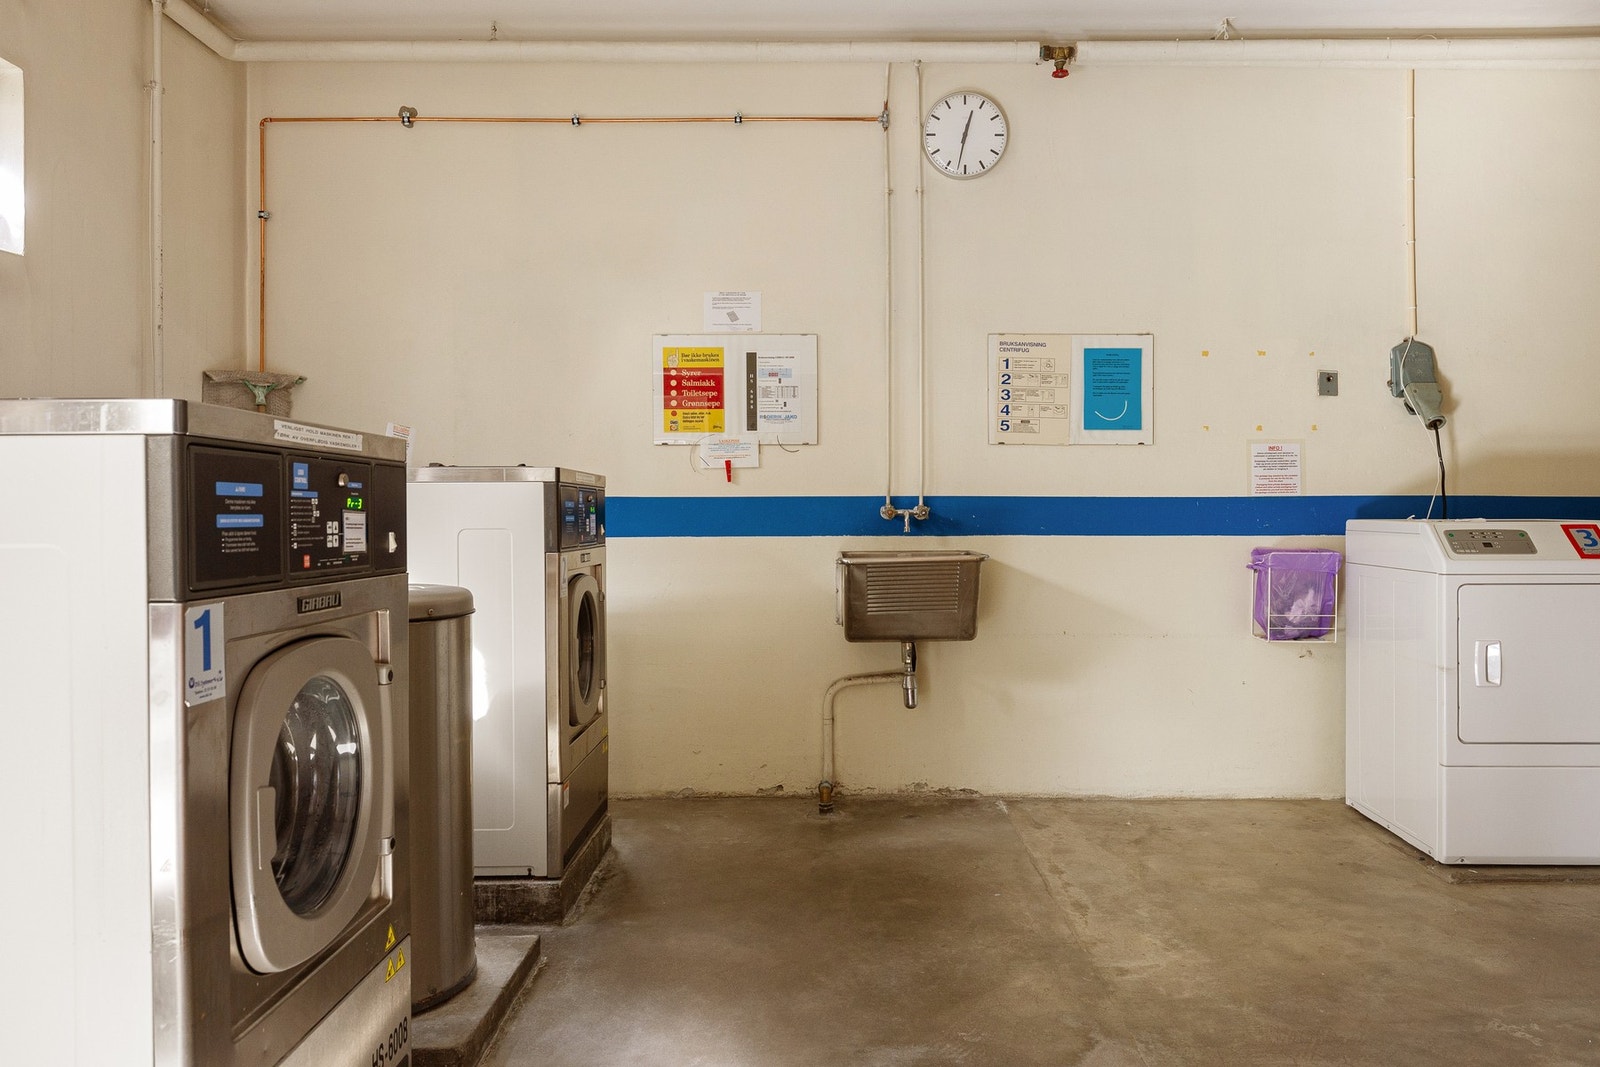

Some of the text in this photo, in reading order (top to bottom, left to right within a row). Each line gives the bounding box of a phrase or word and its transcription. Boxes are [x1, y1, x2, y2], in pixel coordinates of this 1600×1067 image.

[1002, 358, 1009, 369] 1
[681, 369, 702, 379] Syrer
[1001, 373, 1011, 385] 2
[681, 379, 716, 387] Salmiakk
[681, 389, 718, 399] Toiletsepe
[1001, 389, 1011, 400] 3
[681, 399, 721, 409] Grønnsepe
[1000, 404, 1010, 416] 4
[281, 424, 304, 432] VENLIGST
[1000, 420, 1010, 431] 5
[1575, 529, 1599, 547] 3
[302, 593, 339, 612] GIRBAU
[194, 609, 212, 672] 1
